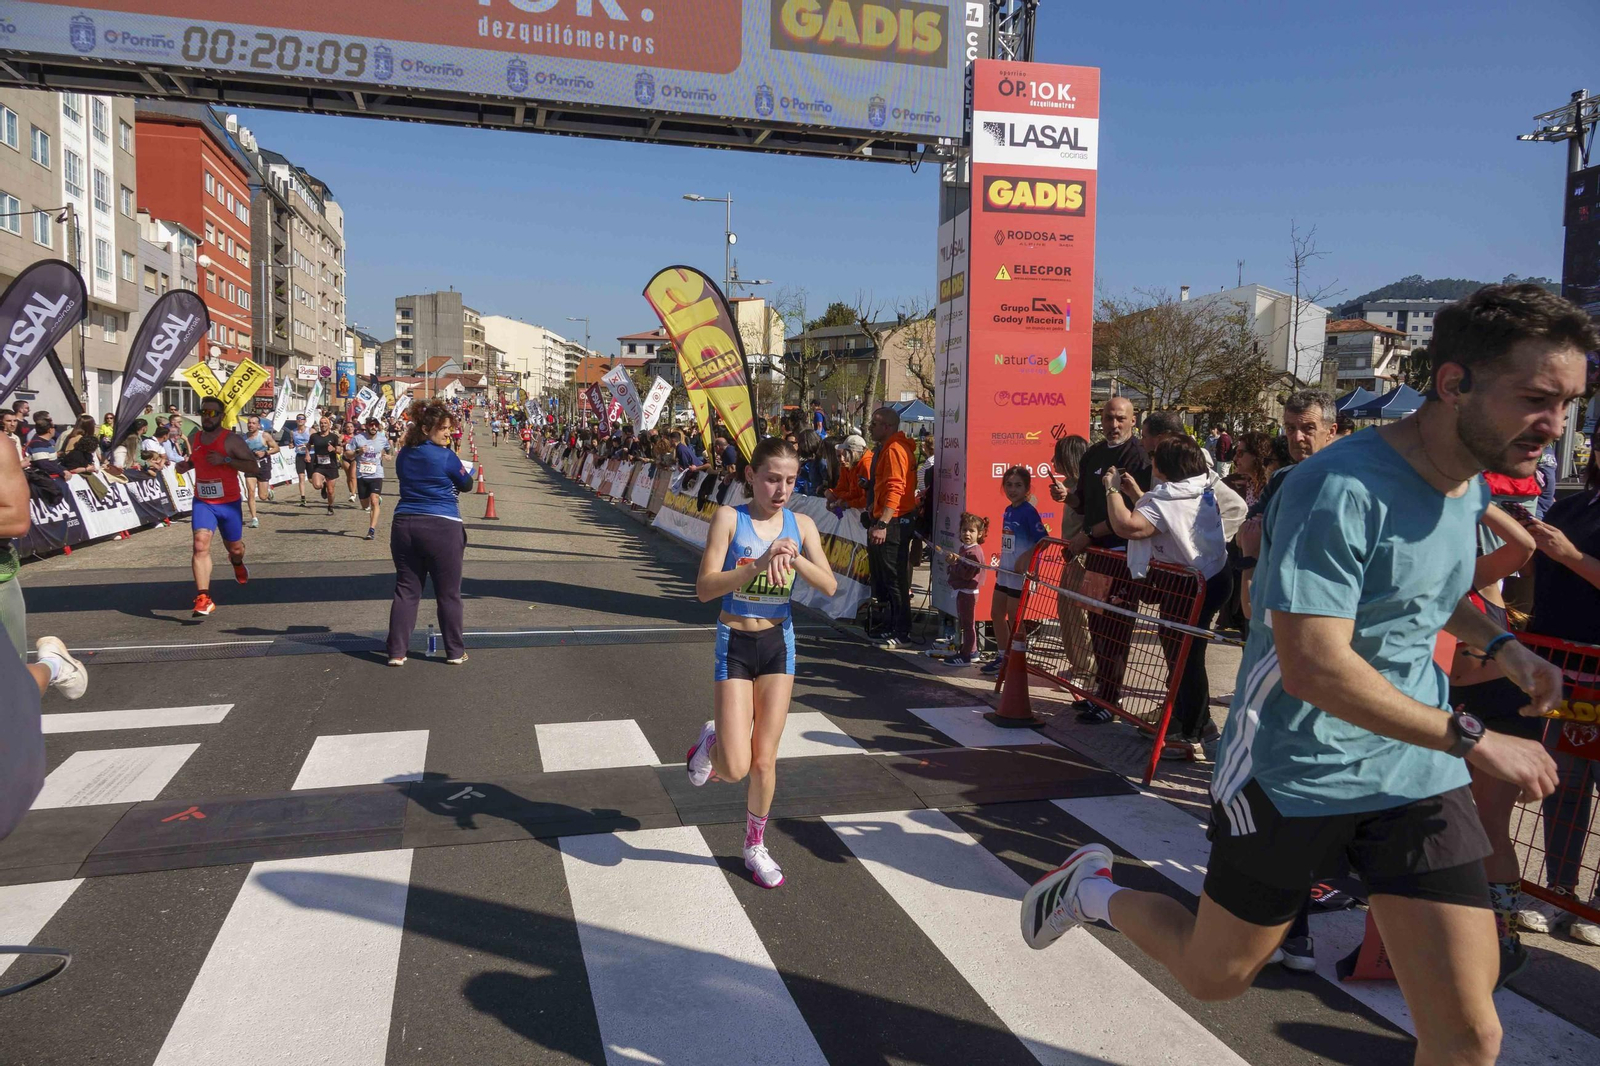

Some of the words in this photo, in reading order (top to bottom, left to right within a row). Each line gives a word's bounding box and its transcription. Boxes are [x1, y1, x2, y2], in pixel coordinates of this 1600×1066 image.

[781, 0, 942, 53] GADIS
[477, 16, 655, 55] dezquilómetros
[181, 25, 367, 77] 00:20:09
[1009, 123, 1088, 151] LASAL
[1060, 151, 1088, 160] cocinas
[988, 179, 1083, 210] GADIS
[1007, 230, 1057, 242] RODOSA
[1013, 265, 1072, 276] ELECPOR
[1000, 304, 1030, 313] Grupo
[993, 315, 1024, 325] Godoy
[1025, 316, 1064, 325] Maceira
[136, 313, 194, 384] LASAL
[994, 354, 1049, 366] NaturGas
[223, 366, 257, 405] LECPOR
[1011, 392, 1066, 407] CEAMSA
[991, 432, 1025, 440] REGATTA
[201, 485, 217, 495] 809
